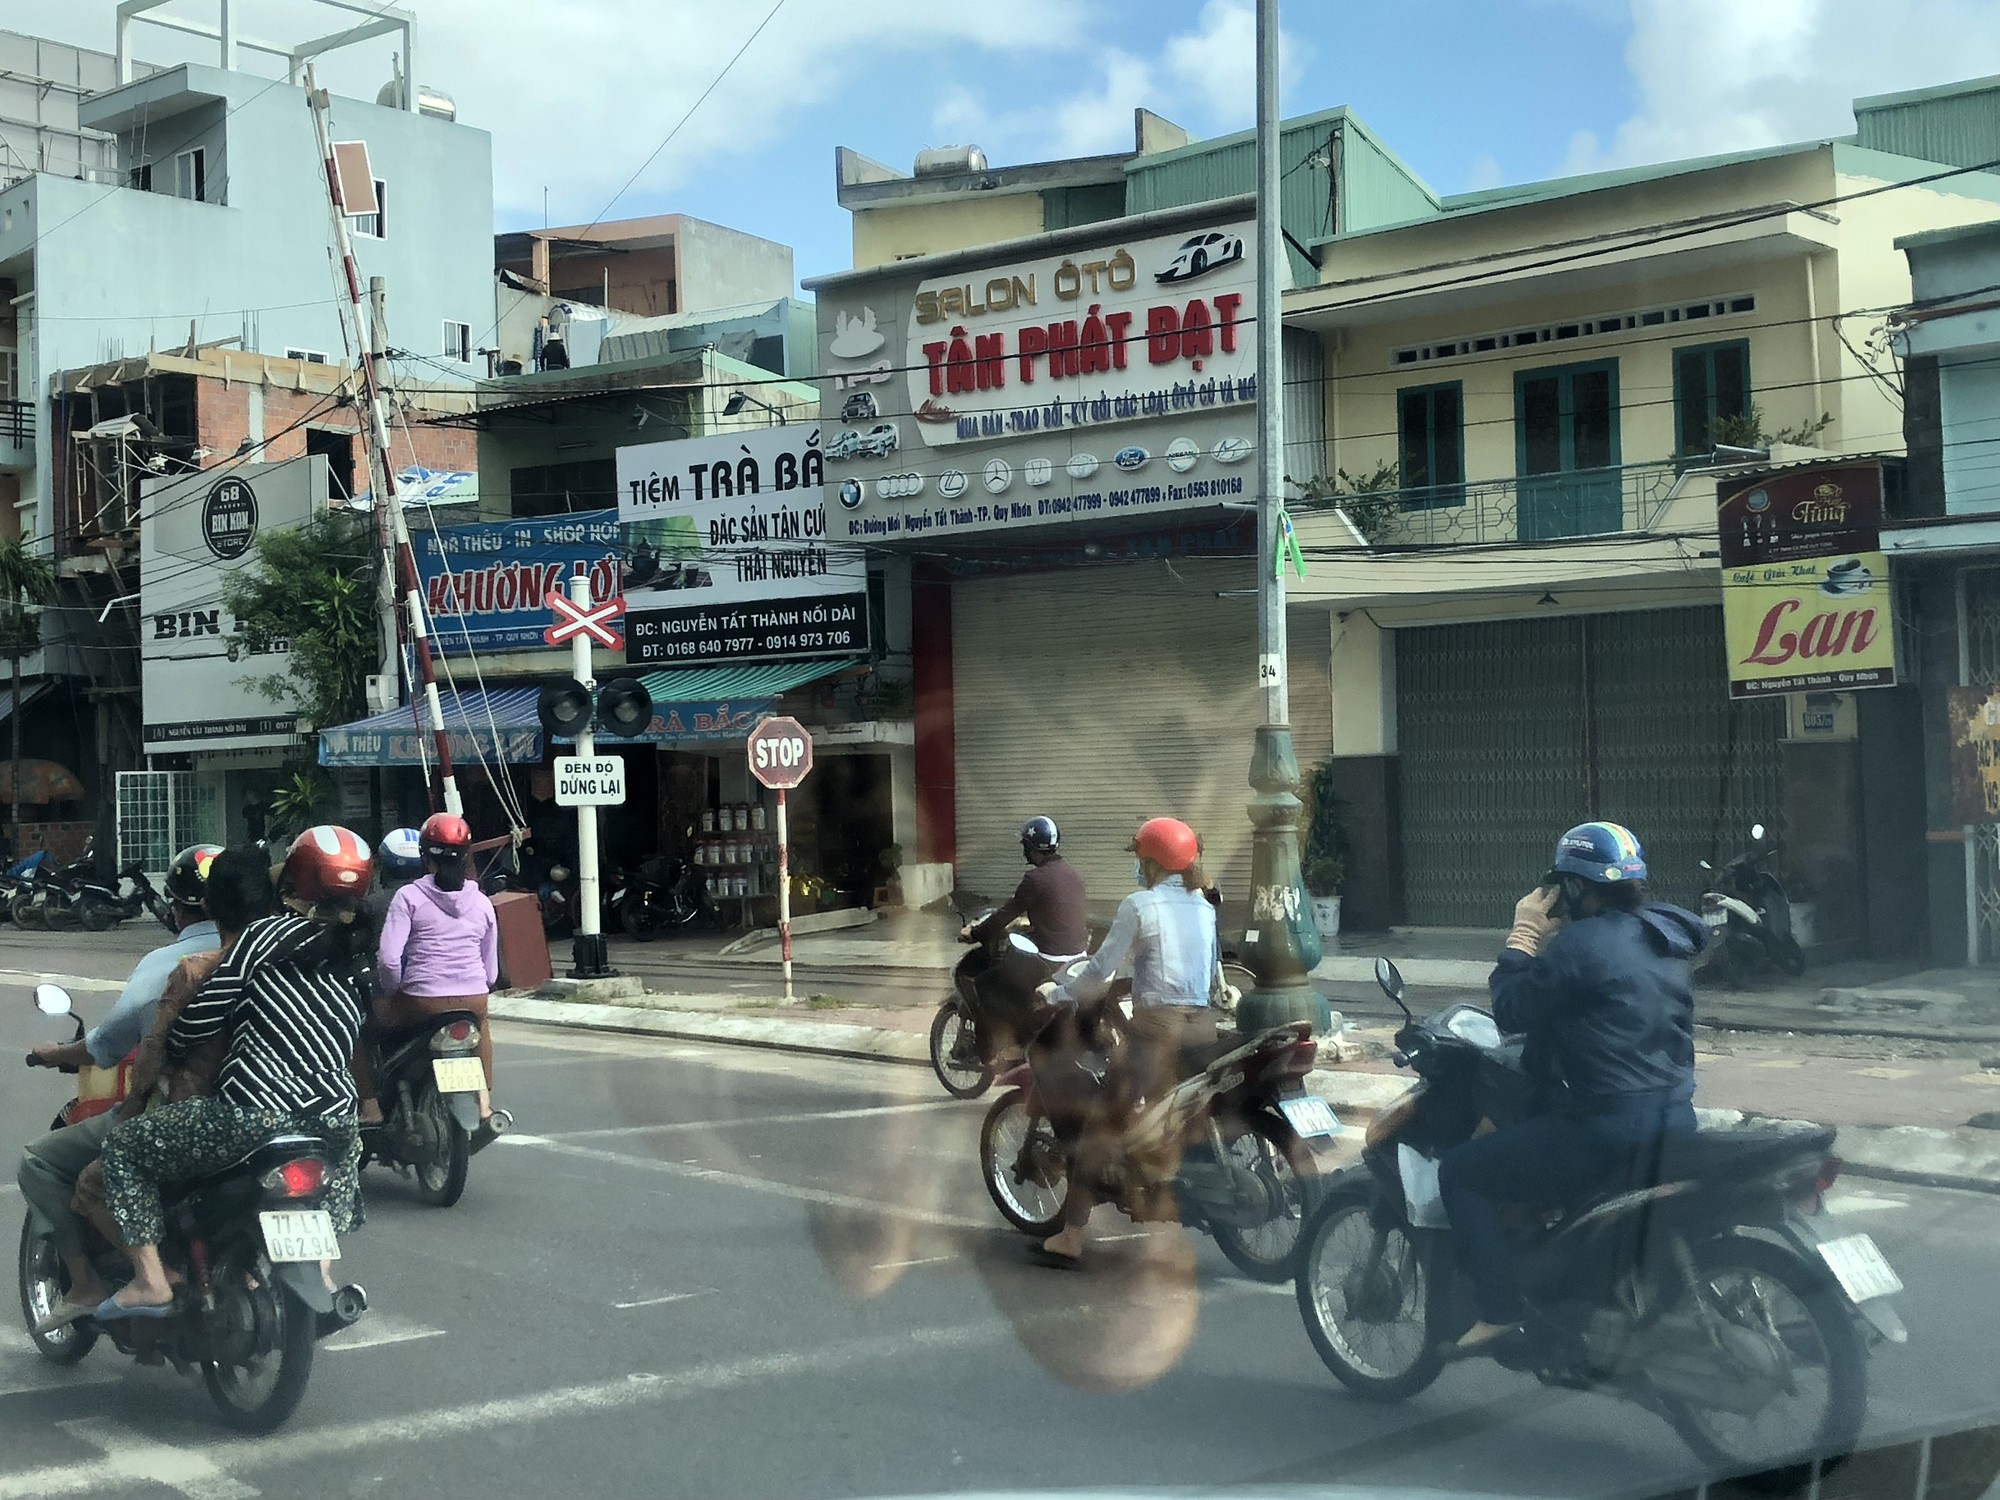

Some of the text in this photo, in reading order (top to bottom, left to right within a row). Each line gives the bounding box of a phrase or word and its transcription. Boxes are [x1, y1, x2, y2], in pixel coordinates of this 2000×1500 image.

[916, 248, 1136, 324] SALON ÔTÔ
[922, 292, 1242, 397] TÂN PHÁT ĐẠT
[629, 428, 824, 509] TIỆM TRÀ BẮ
[220, 486, 240, 502] 68
[211, 513, 229, 533] BIN
[741, 505, 768, 542] SẢN
[771, 505, 799, 539] TÂN
[934, 507, 948, 527] Tất
[993, 504, 1009, 523] Quy
[217, 537, 244, 548] STORE
[462, 529, 502, 552] THÊU
[515, 529, 531, 548] IN
[543, 524, 585, 543] SHOP
[153, 609, 221, 640] BIN
[636, 622, 659, 637] ĐC:
[661, 612, 718, 634] NGUYỄN
[720, 610, 746, 630] TẤT
[751, 607, 799, 628] THÀNH
[802, 603, 827, 623] NỐI
[831, 606, 856, 621] DÀI
[1738, 597, 1879, 667] Lan
[642, 642, 664, 657] ĐT:
[666, 640, 696, 656] 0168
[699, 639, 722, 654] 640
[724, 637, 755, 652] 7977
[766, 634, 797, 650] 0914
[800, 632, 823, 647] 973
[827, 630, 850, 645] 706
[1261, 664, 1276, 679] 34
[1838, 673, 1855, 683] Quy
[644, 710, 685, 733] RÀ
[756, 737, 804, 769] STOP
[600, 779, 621, 797] LẠI
